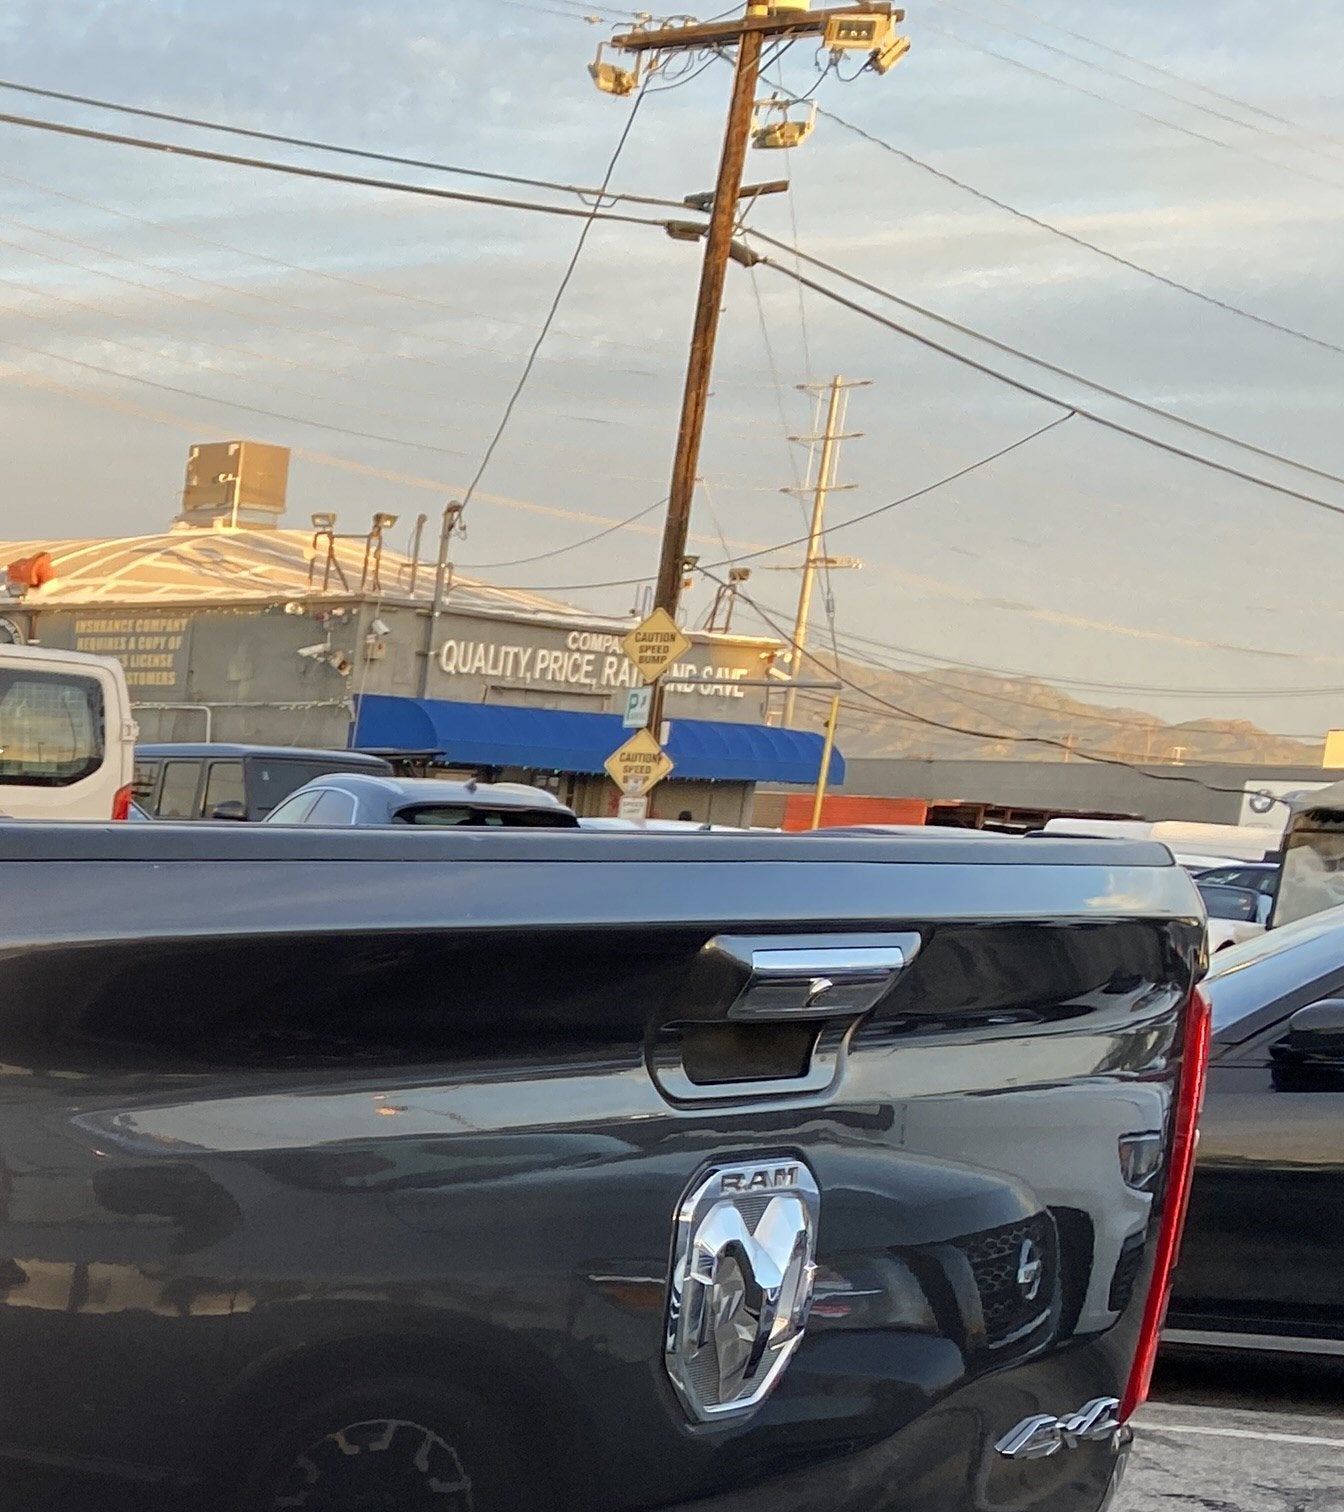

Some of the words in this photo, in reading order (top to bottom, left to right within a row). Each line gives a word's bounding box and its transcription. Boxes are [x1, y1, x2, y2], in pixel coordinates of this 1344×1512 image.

[568, 630, 623, 653] COMPA
[634, 631, 677, 643] CAUTION
[638, 645, 670, 654] SPEED
[638, 655, 668, 664] BUMP
[442, 639, 533, 684] QUALITY,
[534, 648, 597, 690] PRICE,
[664, 662, 697, 693] ND
[124, 671, 176, 685] STOMERS
[619, 752, 659, 763] CAUTION
[622, 765, 652, 774] SPEED
[622, 775, 650, 784] BP
[719, 1166, 799, 1195] RAM
